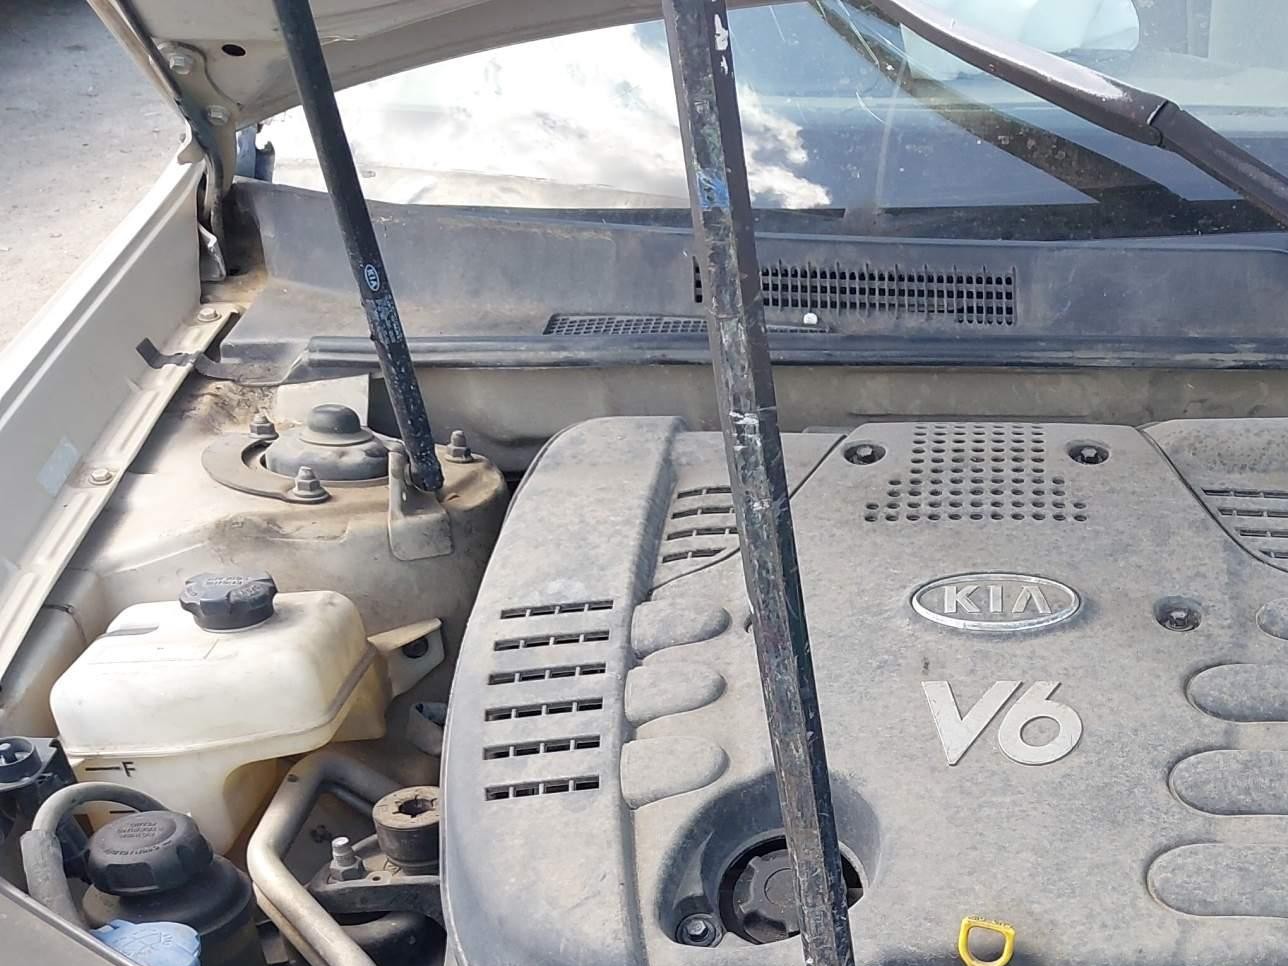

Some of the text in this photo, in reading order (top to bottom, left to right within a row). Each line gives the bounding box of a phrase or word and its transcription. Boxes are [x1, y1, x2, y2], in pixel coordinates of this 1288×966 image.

[943, 584, 1052, 614] KIA
[921, 680, 1083, 766] V6
[121, 761, 137, 778] F
